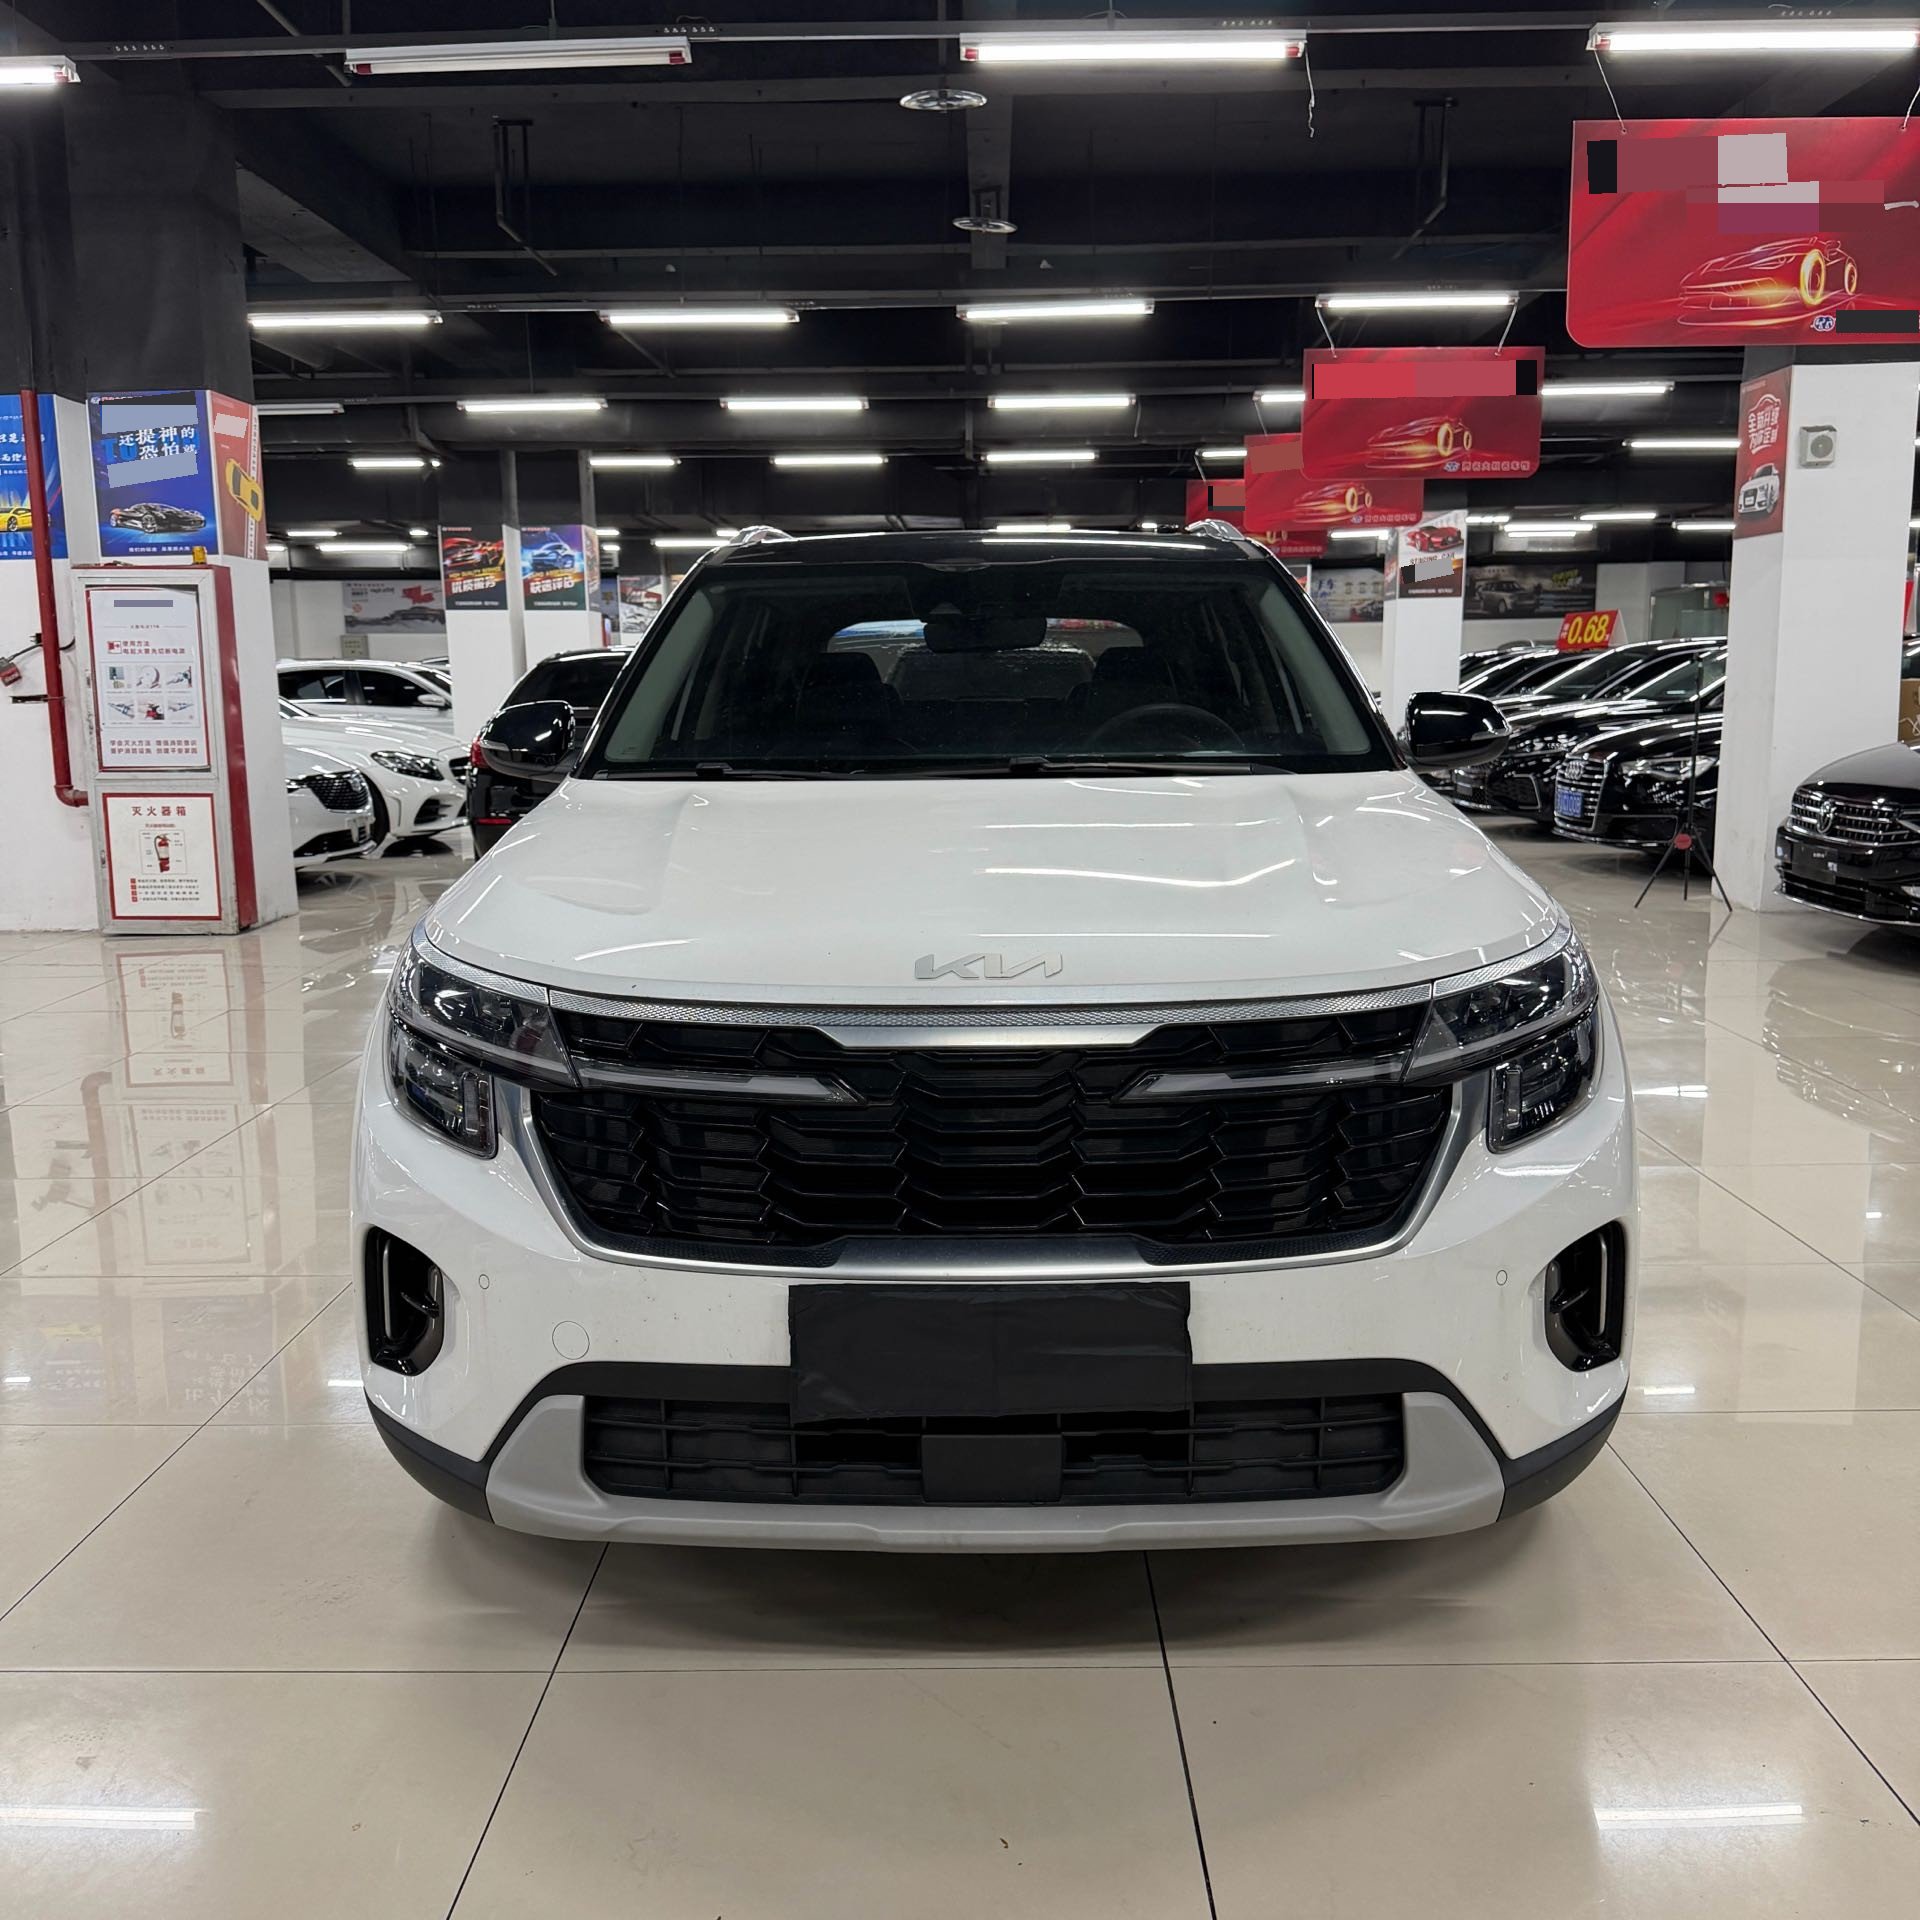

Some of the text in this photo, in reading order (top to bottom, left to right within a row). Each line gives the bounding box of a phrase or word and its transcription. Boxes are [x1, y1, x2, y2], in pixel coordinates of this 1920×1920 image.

[118, 426, 195, 446] 还提神的
[451, 576, 496, 594] 优质服务
[1568, 613, 1609, 645] 0.68
[131, 806, 187, 817] 灭火器箱
[914, 952, 1063, 979] KIA
